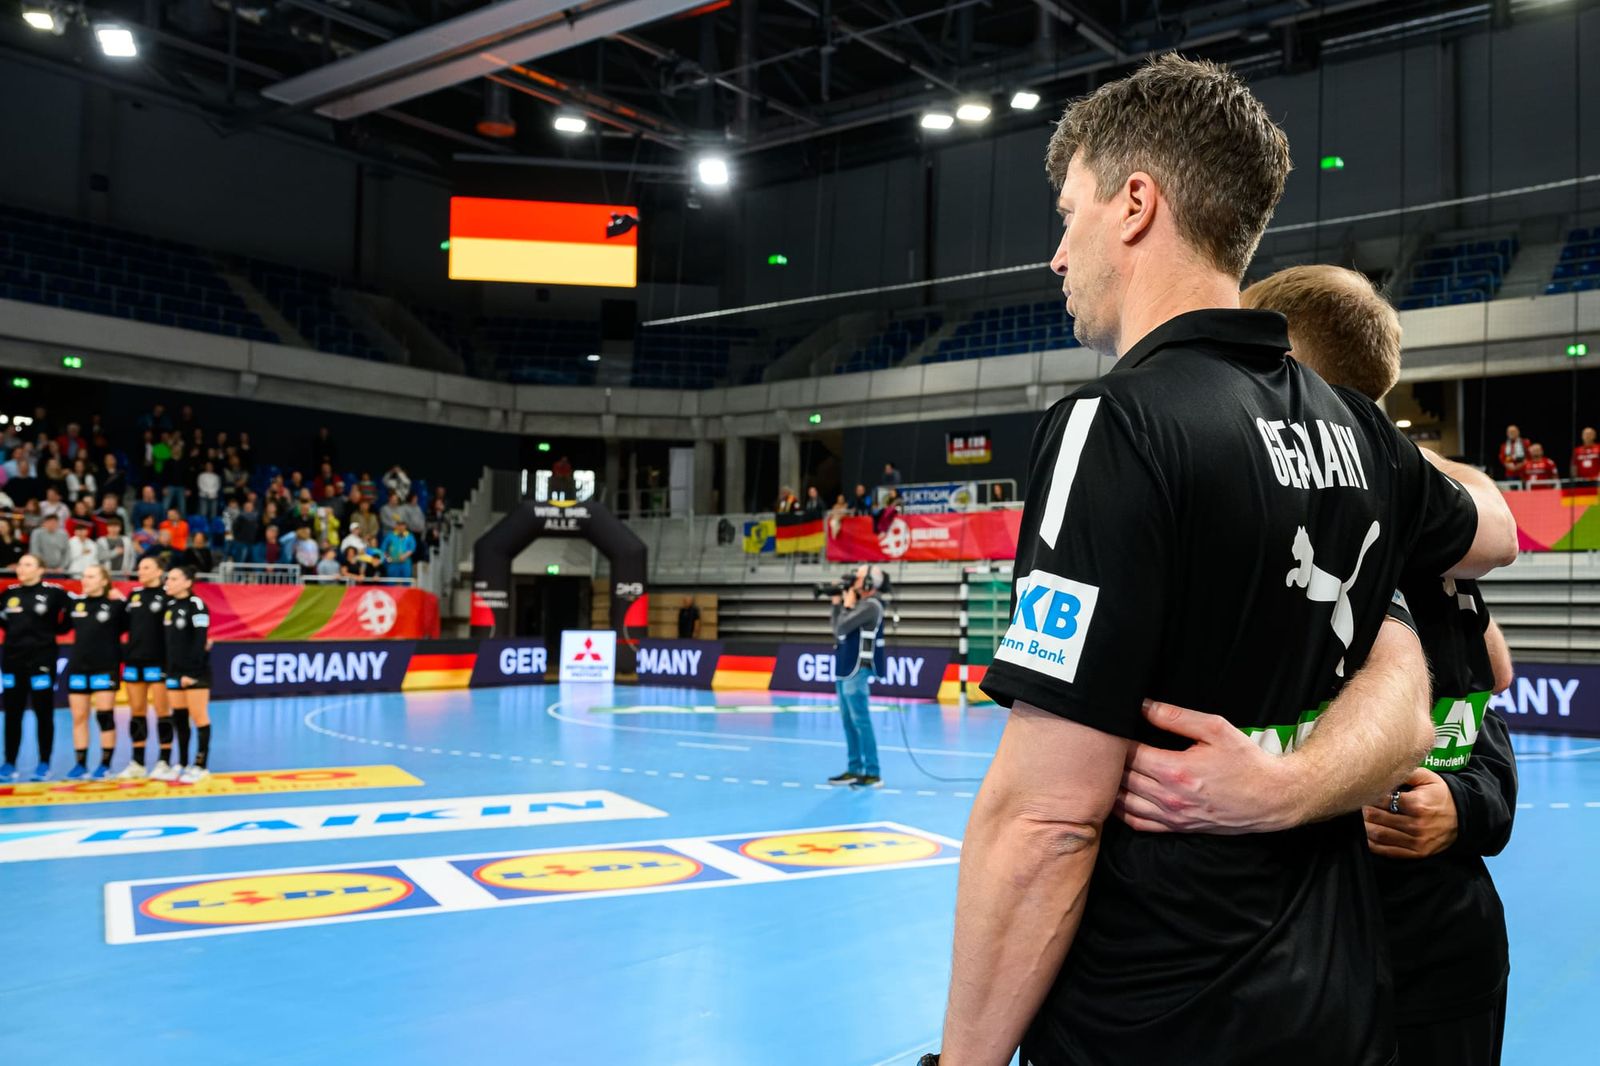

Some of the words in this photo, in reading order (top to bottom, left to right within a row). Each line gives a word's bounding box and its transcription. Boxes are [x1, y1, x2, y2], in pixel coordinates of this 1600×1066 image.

[1012, 584, 1082, 640] KB
[636, 648, 702, 676] MANY
[1000, 637, 1024, 651] ann
[1027, 639, 1067, 665] Bank
[230, 651, 389, 685] GERMANY
[797, 653, 924, 686] GENY
[1424, 754, 1465, 767] Handerk
[77, 799, 606, 843] DAIKIN
[168, 885, 393, 910] LIDL
